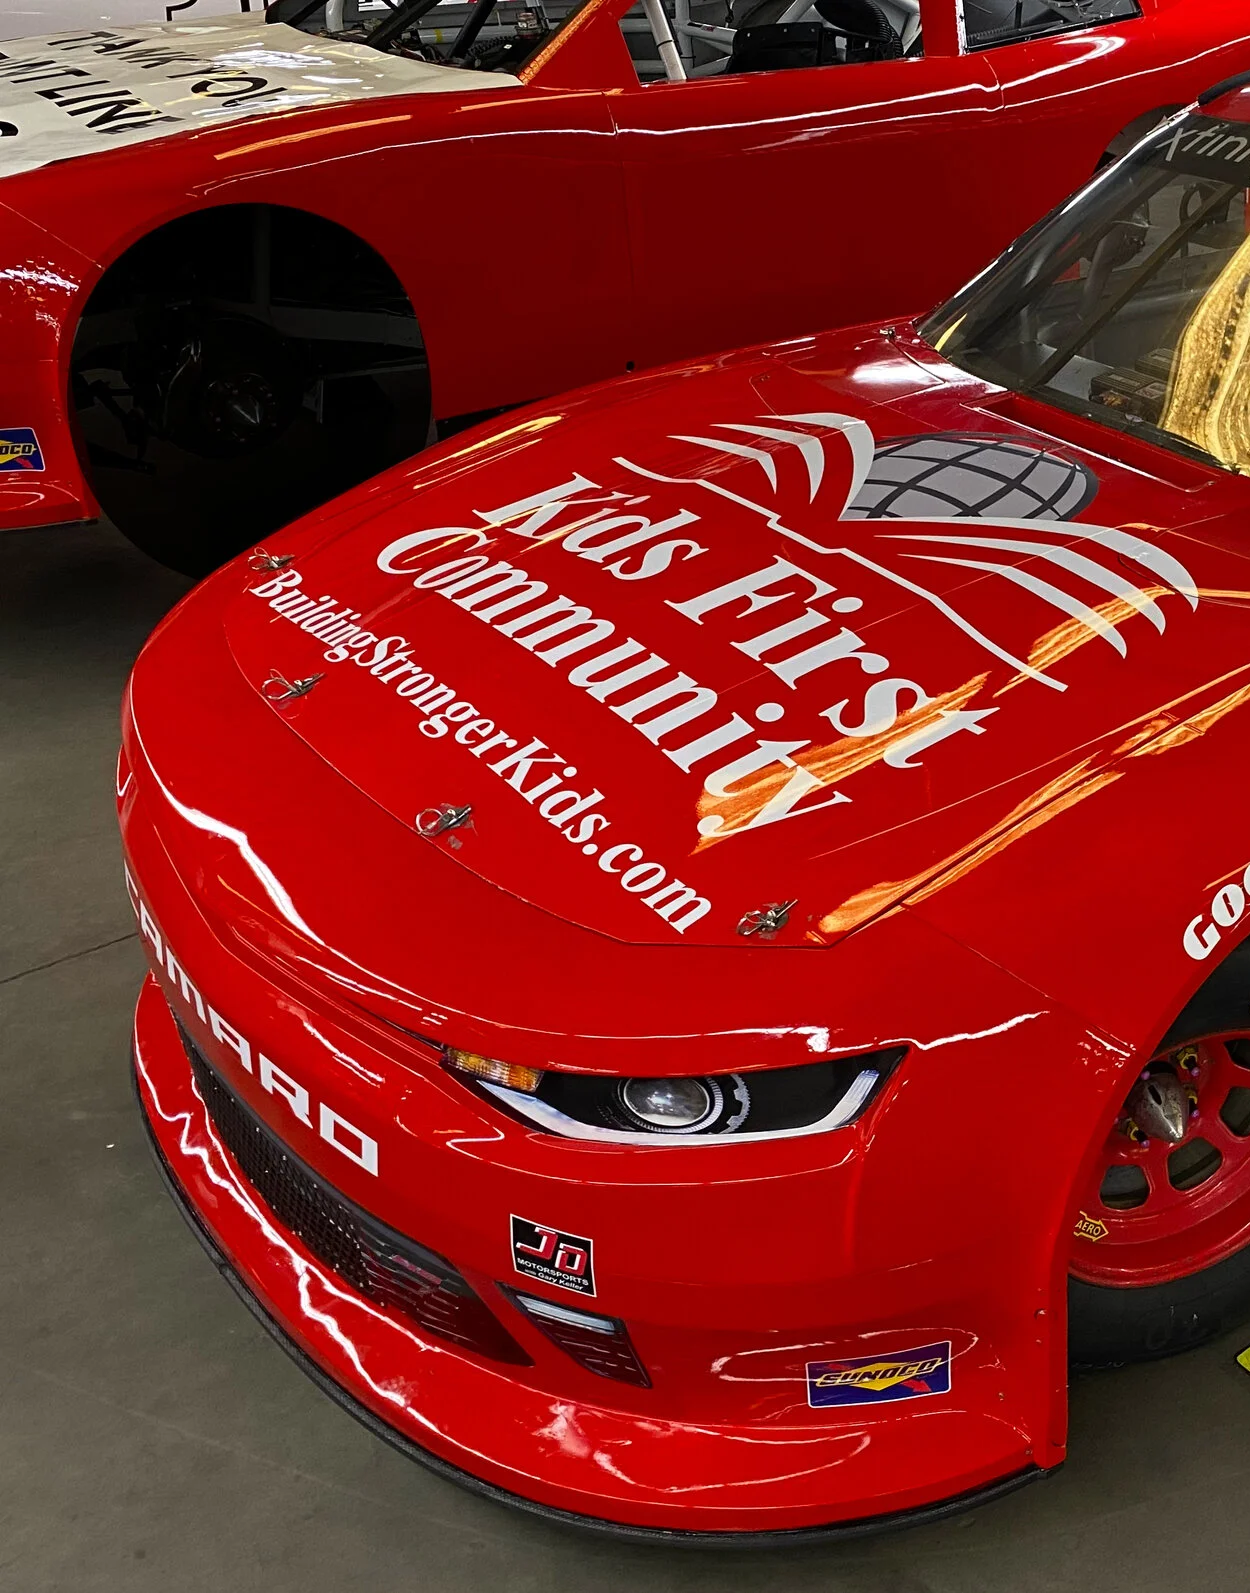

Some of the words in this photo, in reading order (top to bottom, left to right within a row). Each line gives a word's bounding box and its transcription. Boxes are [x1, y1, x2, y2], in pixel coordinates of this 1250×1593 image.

[472, 470, 709, 582] Kids
[665, 553, 1001, 770] First
[375, 526, 853, 839] Community
[247, 568, 713, 935] BuildingStrongerKids.com
[1074, 1219, 1102, 1236] AERO
[516, 1257, 589, 1286] MOTORSPORTS
[538, 1272, 558, 1283] Gary
[559, 1279, 584, 1291] Keller
[815, 1357, 942, 1387] SUNOCO
